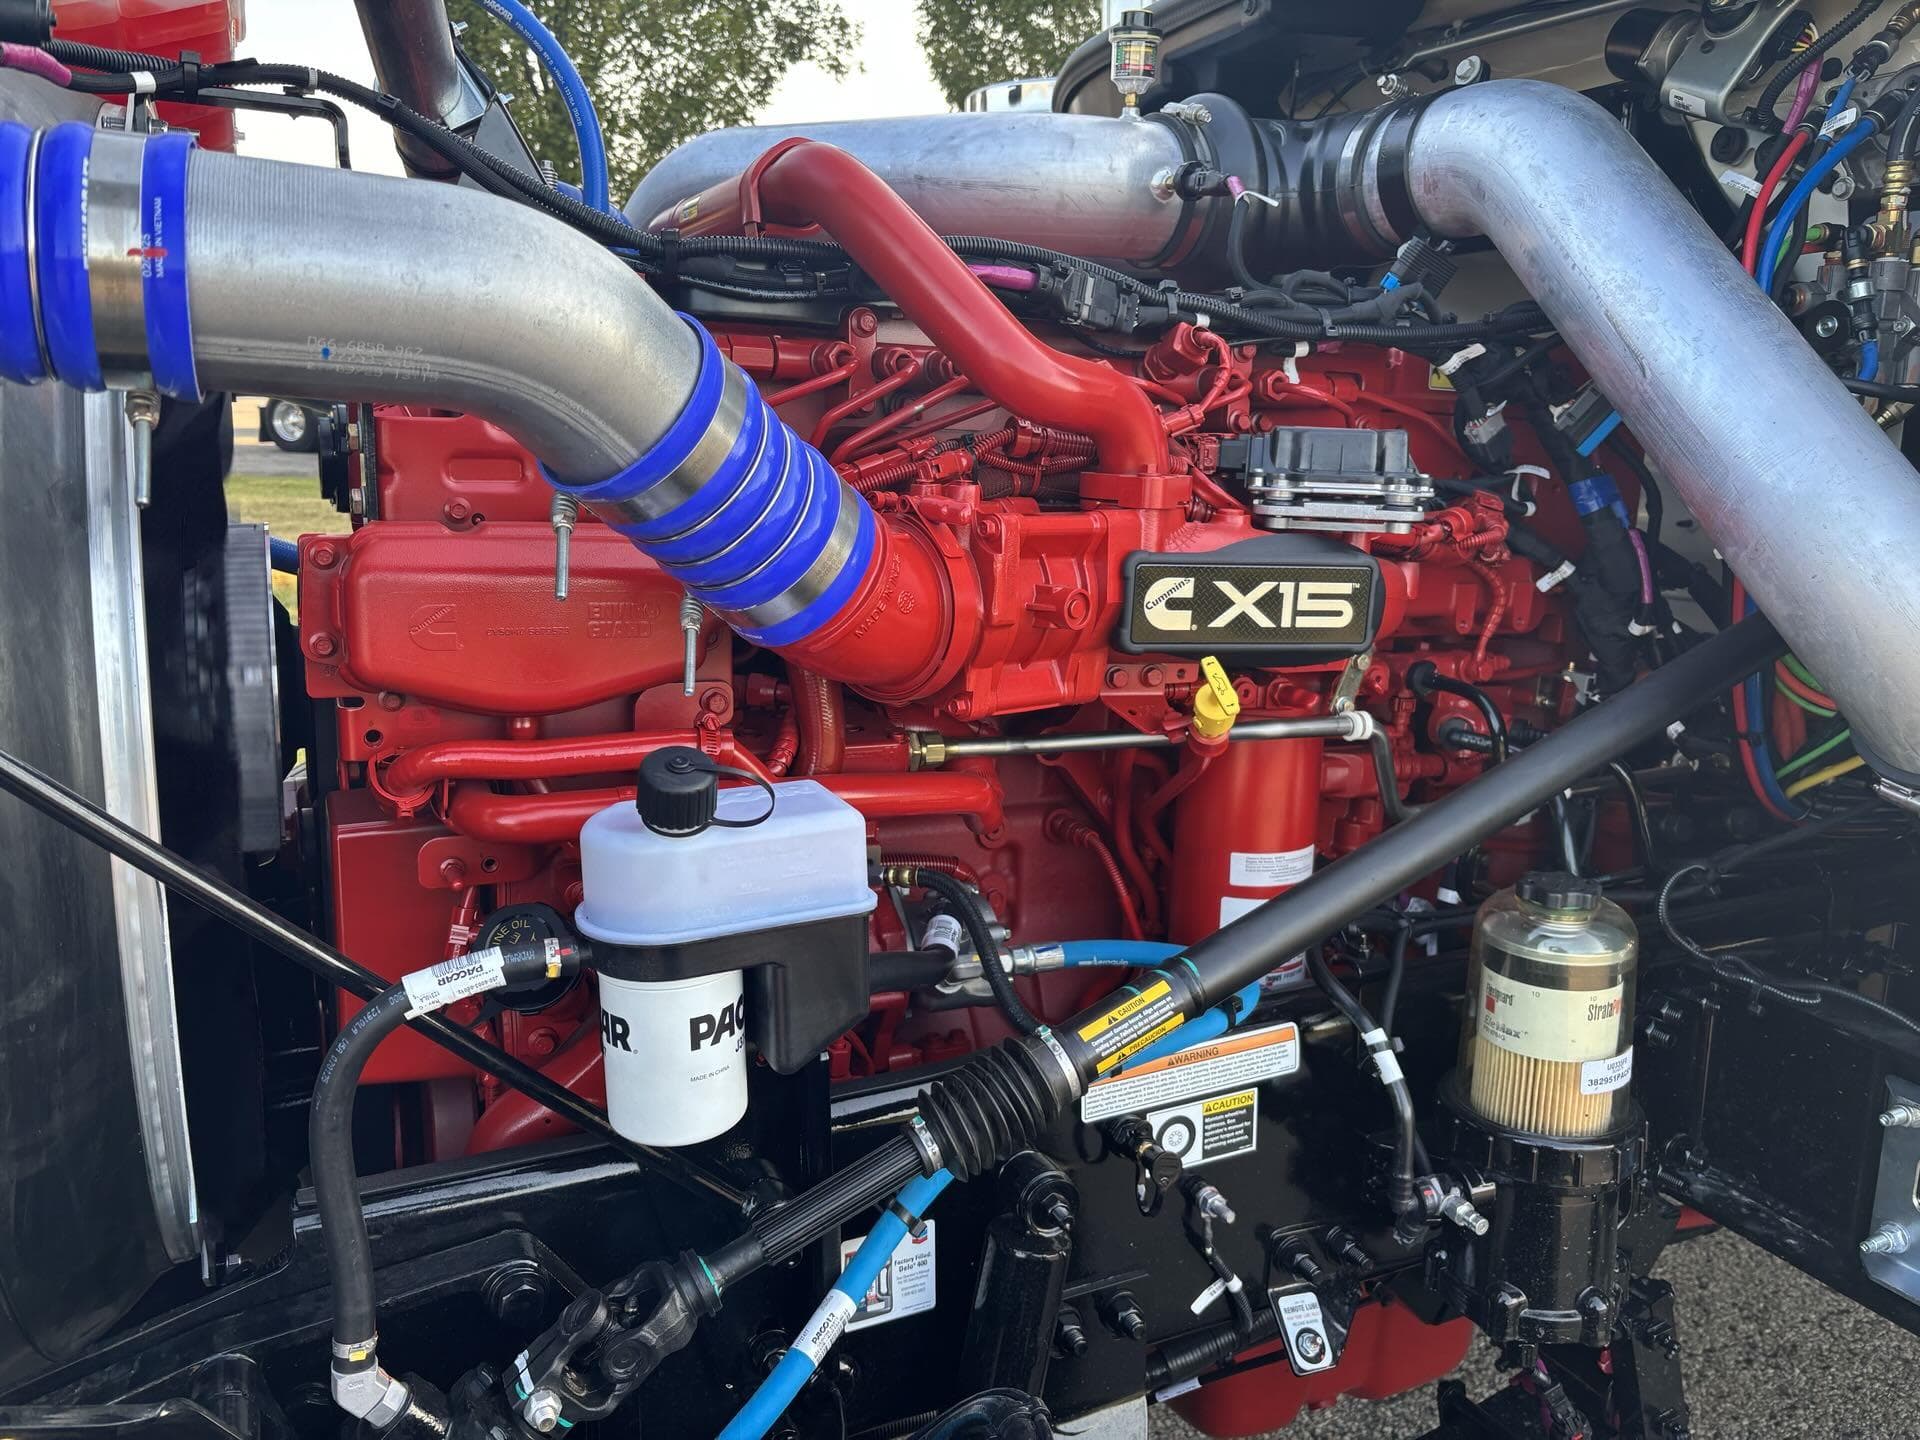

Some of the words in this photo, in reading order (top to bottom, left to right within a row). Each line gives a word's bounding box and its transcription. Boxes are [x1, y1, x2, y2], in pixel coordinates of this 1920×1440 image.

[154, 197, 162, 236] VIETNAM
[1145, 578, 1191, 610] Cummins
[1207, 581, 1354, 628] X15
[855, 601, 887, 639] MADE
[512, 920, 530, 929] OIL
[438, 964, 484, 987] PACCAR
[1117, 996, 1146, 1016] CAUTION
[335, 1038, 349, 1054] USA
[1174, 1047, 1219, 1065] WARNING
[690, 1074, 708, 1083] MADE
[715, 1065, 730, 1077] CHINA
[1212, 1094, 1254, 1110] CAUTION
[895, 1257, 914, 1267] Factory
[1284, 1305, 1305, 1313] REMOTE
